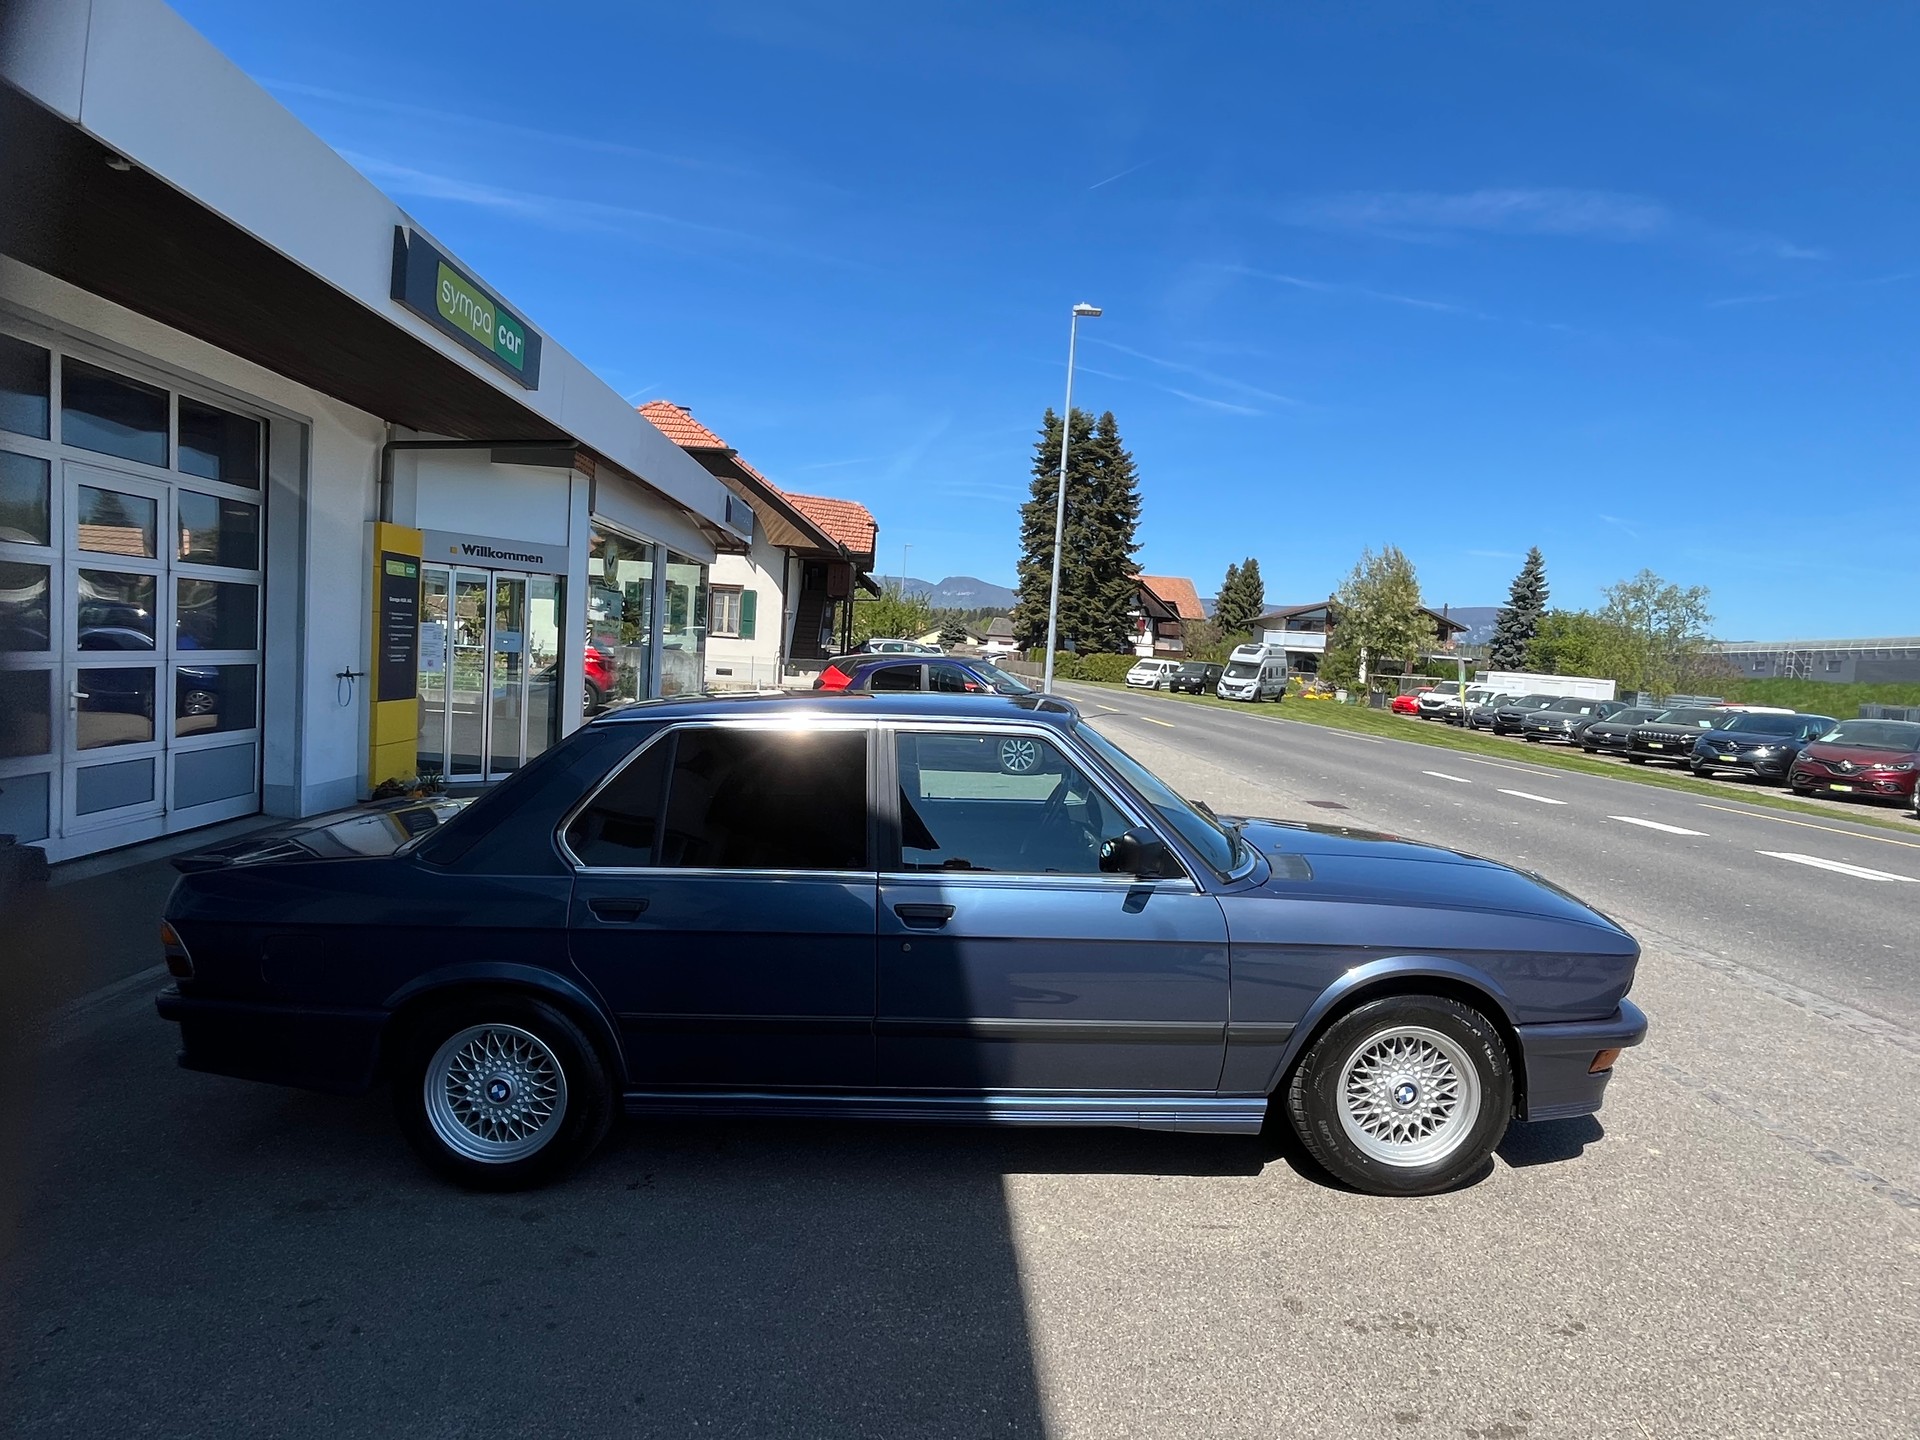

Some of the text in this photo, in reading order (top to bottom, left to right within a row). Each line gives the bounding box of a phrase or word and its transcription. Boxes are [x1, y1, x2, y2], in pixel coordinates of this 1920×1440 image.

[442, 280, 522, 354] sympa car
[461, 543, 544, 564] Willkommen
